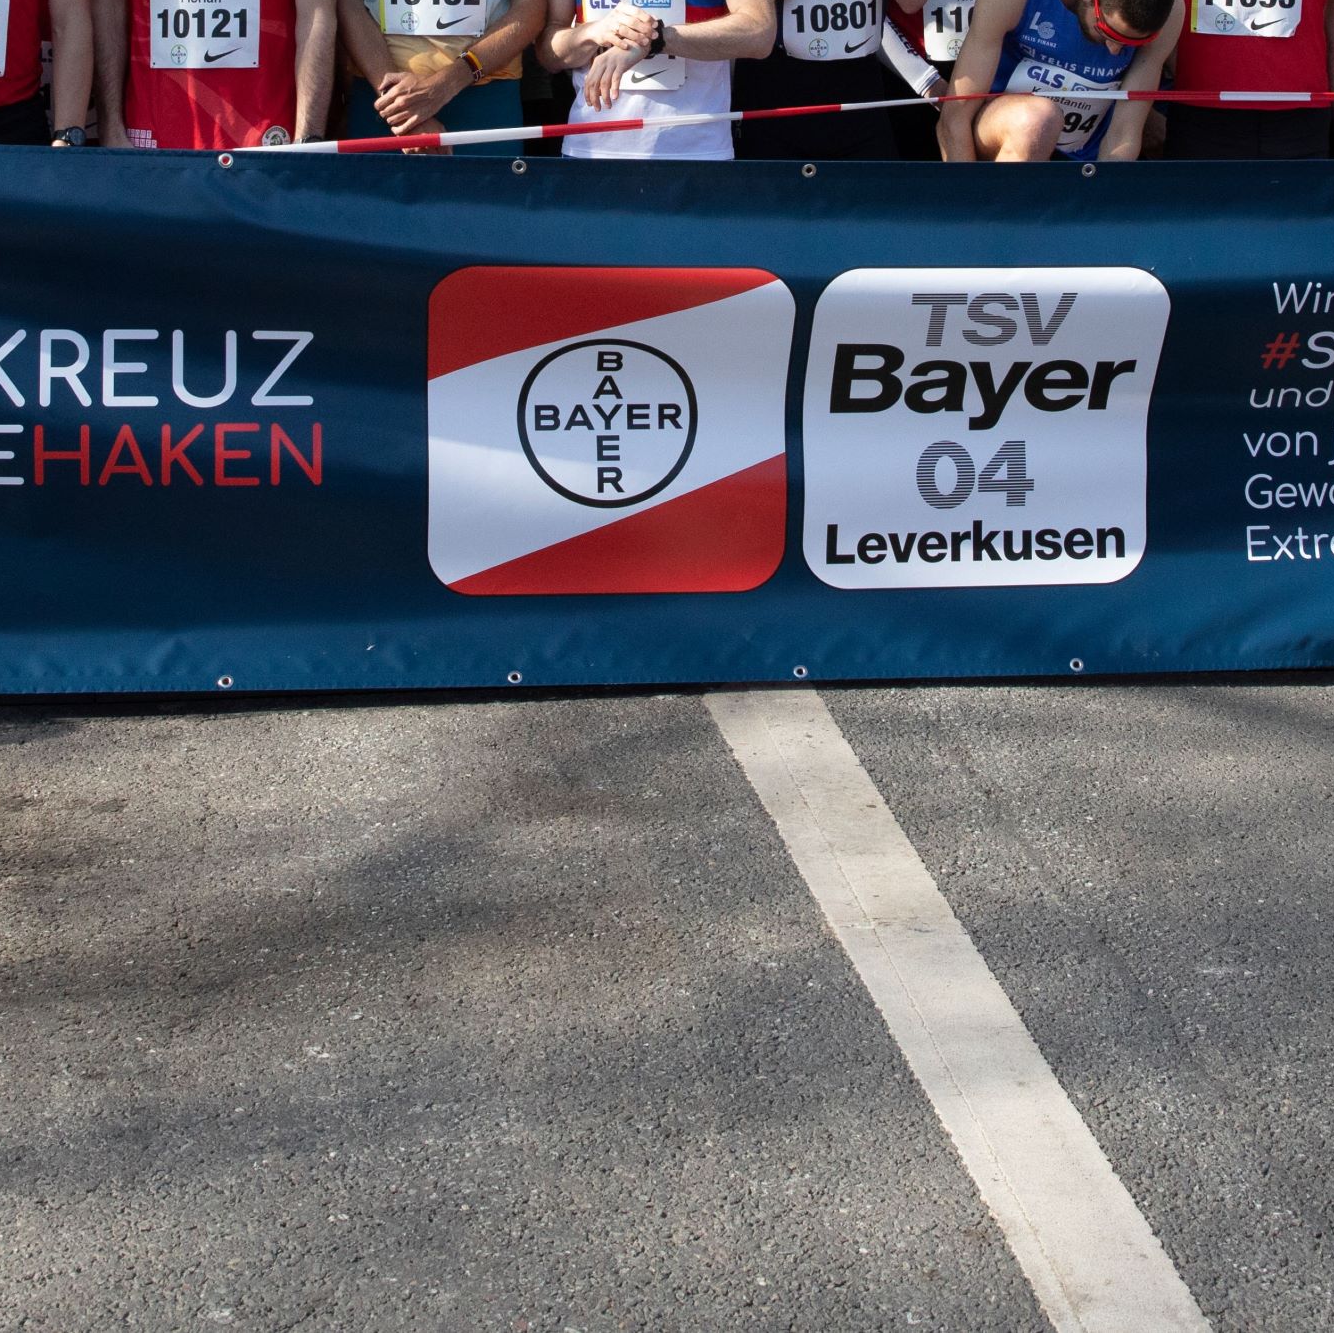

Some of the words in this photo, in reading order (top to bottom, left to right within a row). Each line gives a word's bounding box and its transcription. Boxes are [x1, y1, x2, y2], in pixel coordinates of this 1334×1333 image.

[157, 8, 248, 39] 10121
[1022, 34, 1036, 42] TELIS
[1037, 37, 1057, 48] FINANZ
[1040, 53, 1078, 72] TELIS
[911, 292, 1079, 347] TSV
[829, 343, 1137, 430] Bayer
[1248, 380, 1333, 409] und
[534, 403, 683, 432] BAYER
[1242, 428, 1320, 459] von
[916, 440, 1034, 509] 04
[826, 520, 1127, 565] Leverkusen
